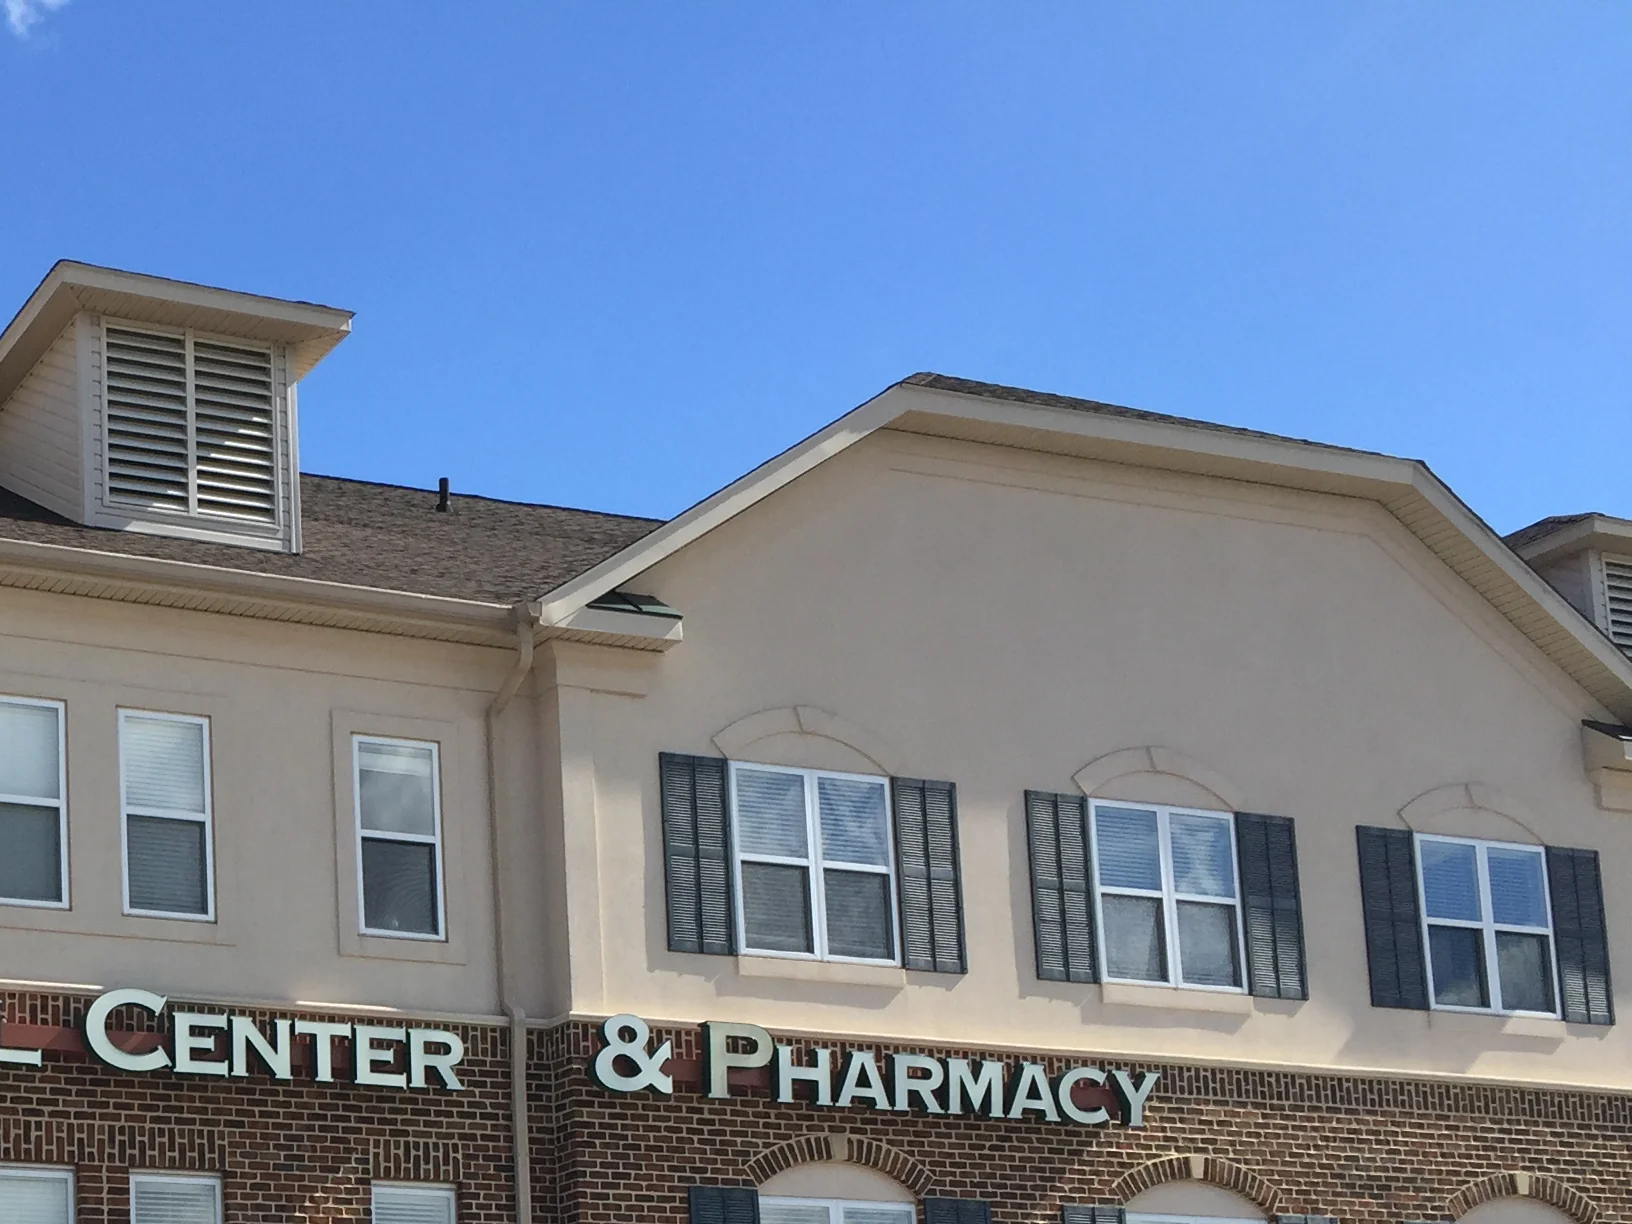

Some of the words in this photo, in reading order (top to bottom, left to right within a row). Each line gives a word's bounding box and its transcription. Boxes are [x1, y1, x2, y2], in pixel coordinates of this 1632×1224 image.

[82, 987, 466, 1091] CENTER
[593, 1013, 673, 1094] &
[701, 1020, 1160, 1127] PHARMACY
